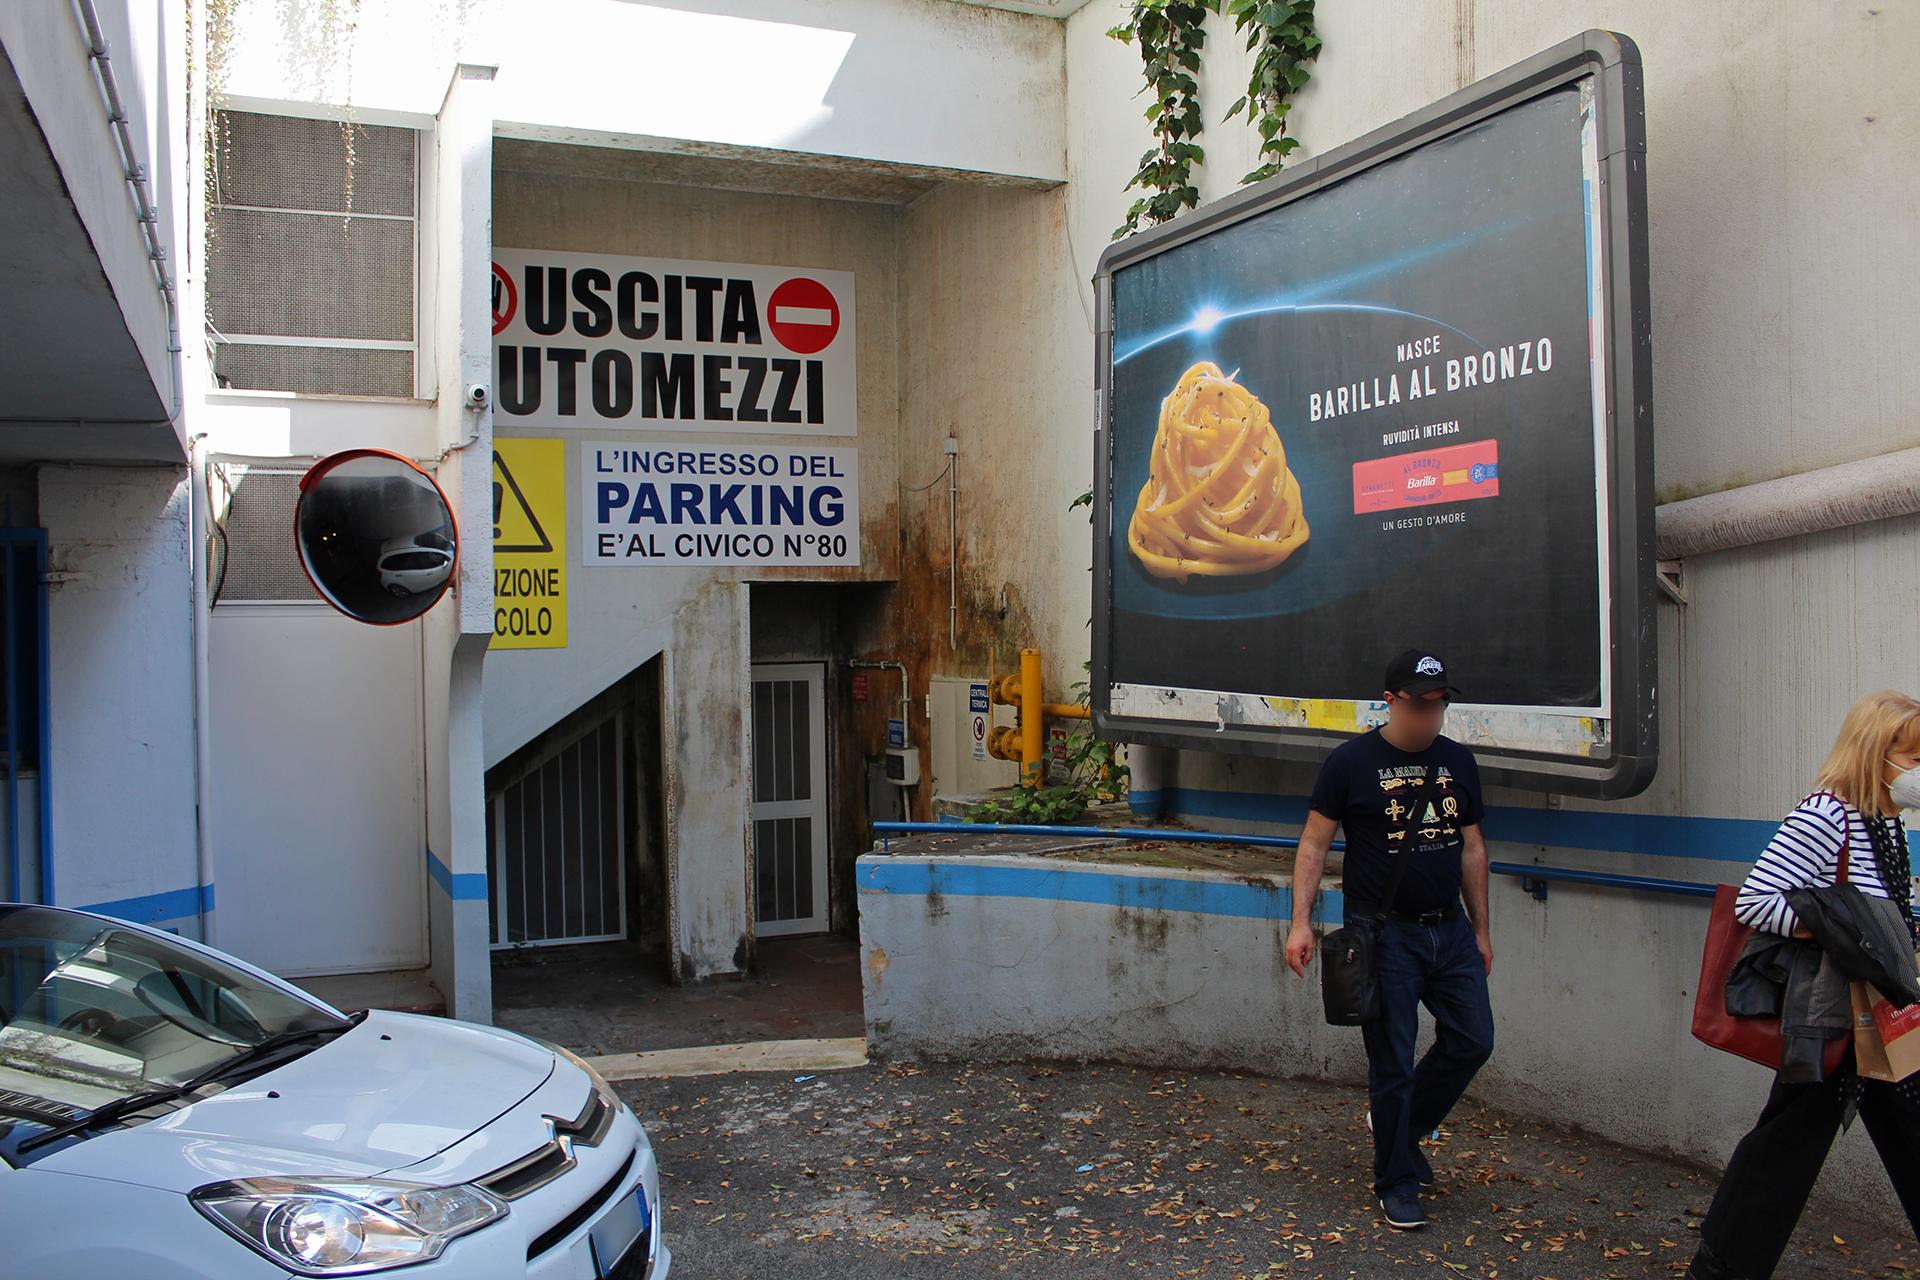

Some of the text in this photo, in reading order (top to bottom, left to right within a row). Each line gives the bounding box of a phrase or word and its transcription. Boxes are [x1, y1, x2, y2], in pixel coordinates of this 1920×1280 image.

[524, 265, 762, 345] USCITA
[1397, 335, 1441, 363] NASCE
[492, 345, 824, 424] UTOMEZZI
[1310, 337, 1552, 422] BARILLA AL BRONZO
[1383, 421, 1460, 446] RUVIDITÀ INTENSA
[789, 456, 844, 478] DEL
[1407, 475, 1437, 489] Barilla
[597, 482, 844, 527] PARKING
[1382, 521, 1394, 531] UN
[1397, 517, 1423, 530] GESTO
[674, 534, 774, 557] CIVICO
